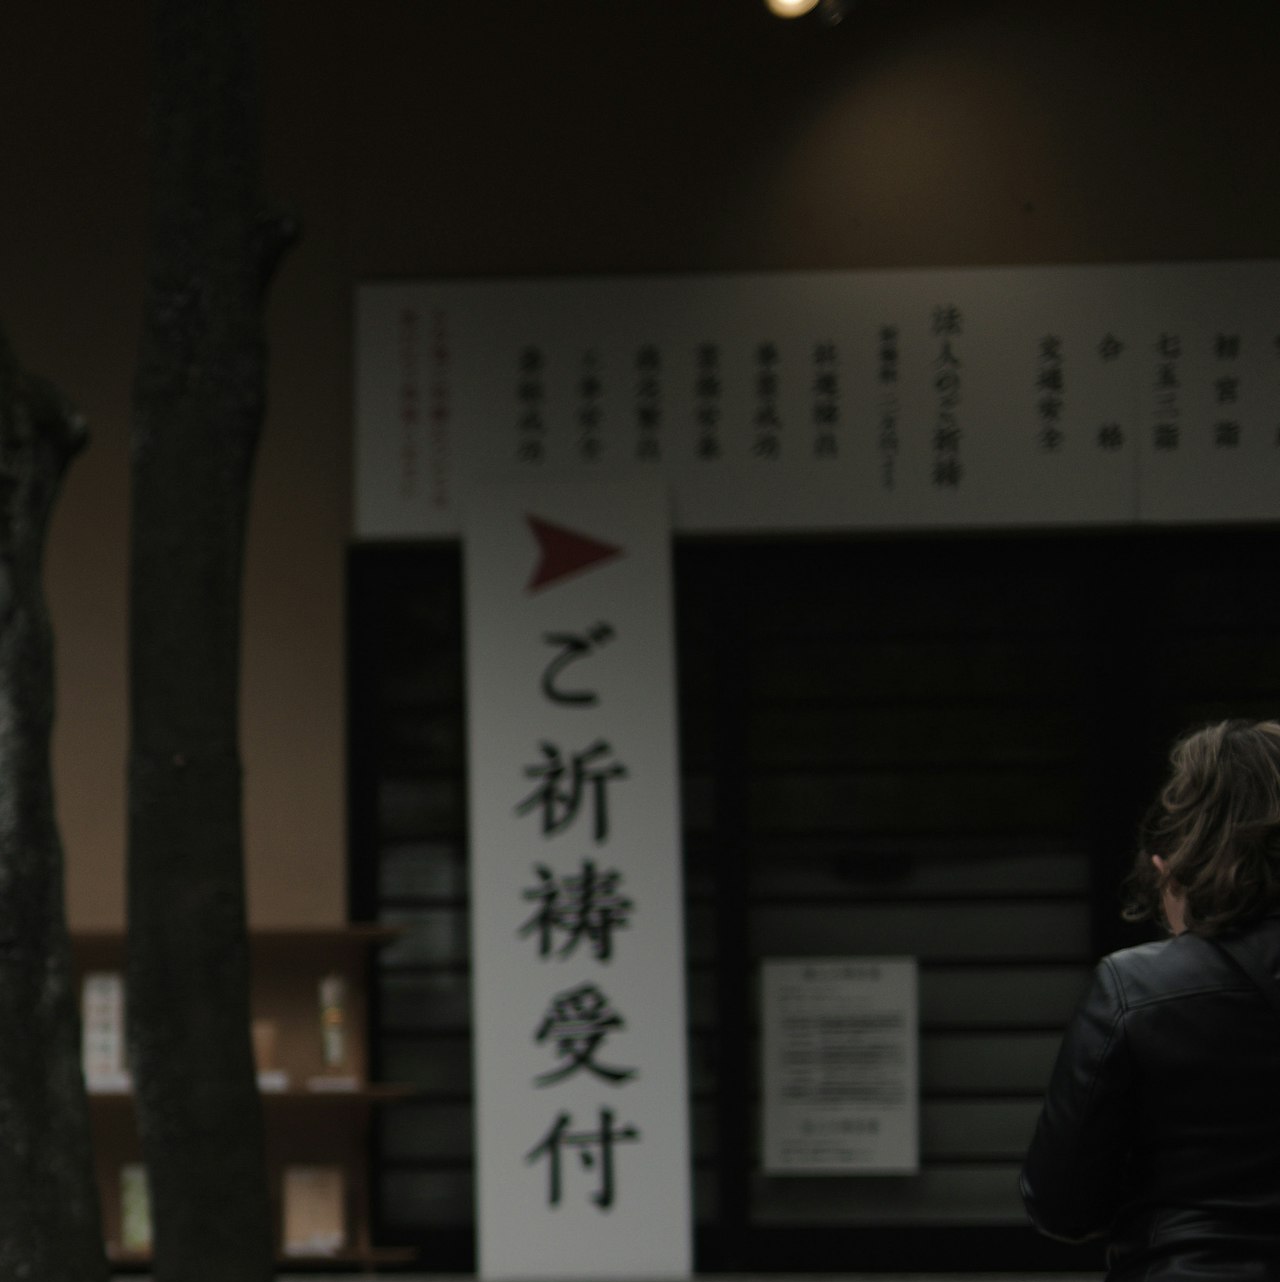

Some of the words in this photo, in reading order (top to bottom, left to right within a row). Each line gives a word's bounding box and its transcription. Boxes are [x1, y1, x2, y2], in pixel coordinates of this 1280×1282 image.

[515, 621, 643, 1212] ご祈祷受付
